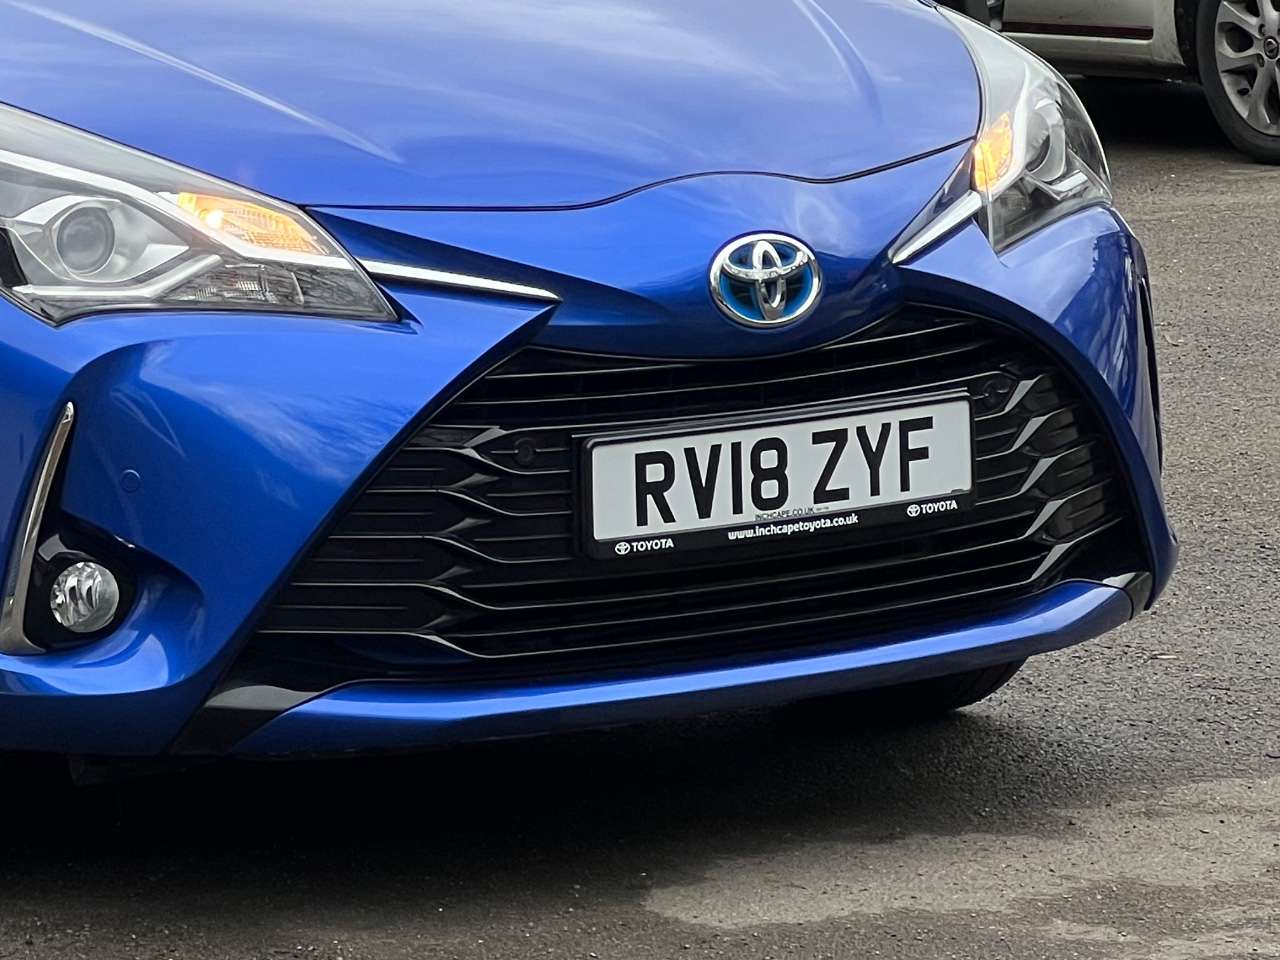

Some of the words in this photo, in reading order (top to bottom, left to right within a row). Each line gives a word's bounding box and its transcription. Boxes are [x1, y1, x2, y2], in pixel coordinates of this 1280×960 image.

[634, 437, 789, 527] RV18
[811, 416, 933, 504] ZYF
[921, 500, 958, 514] TOYOTA
[728, 513, 859, 540] www.inchcapetoyota.co.uk
[631, 538, 674, 552] TOYOTA
